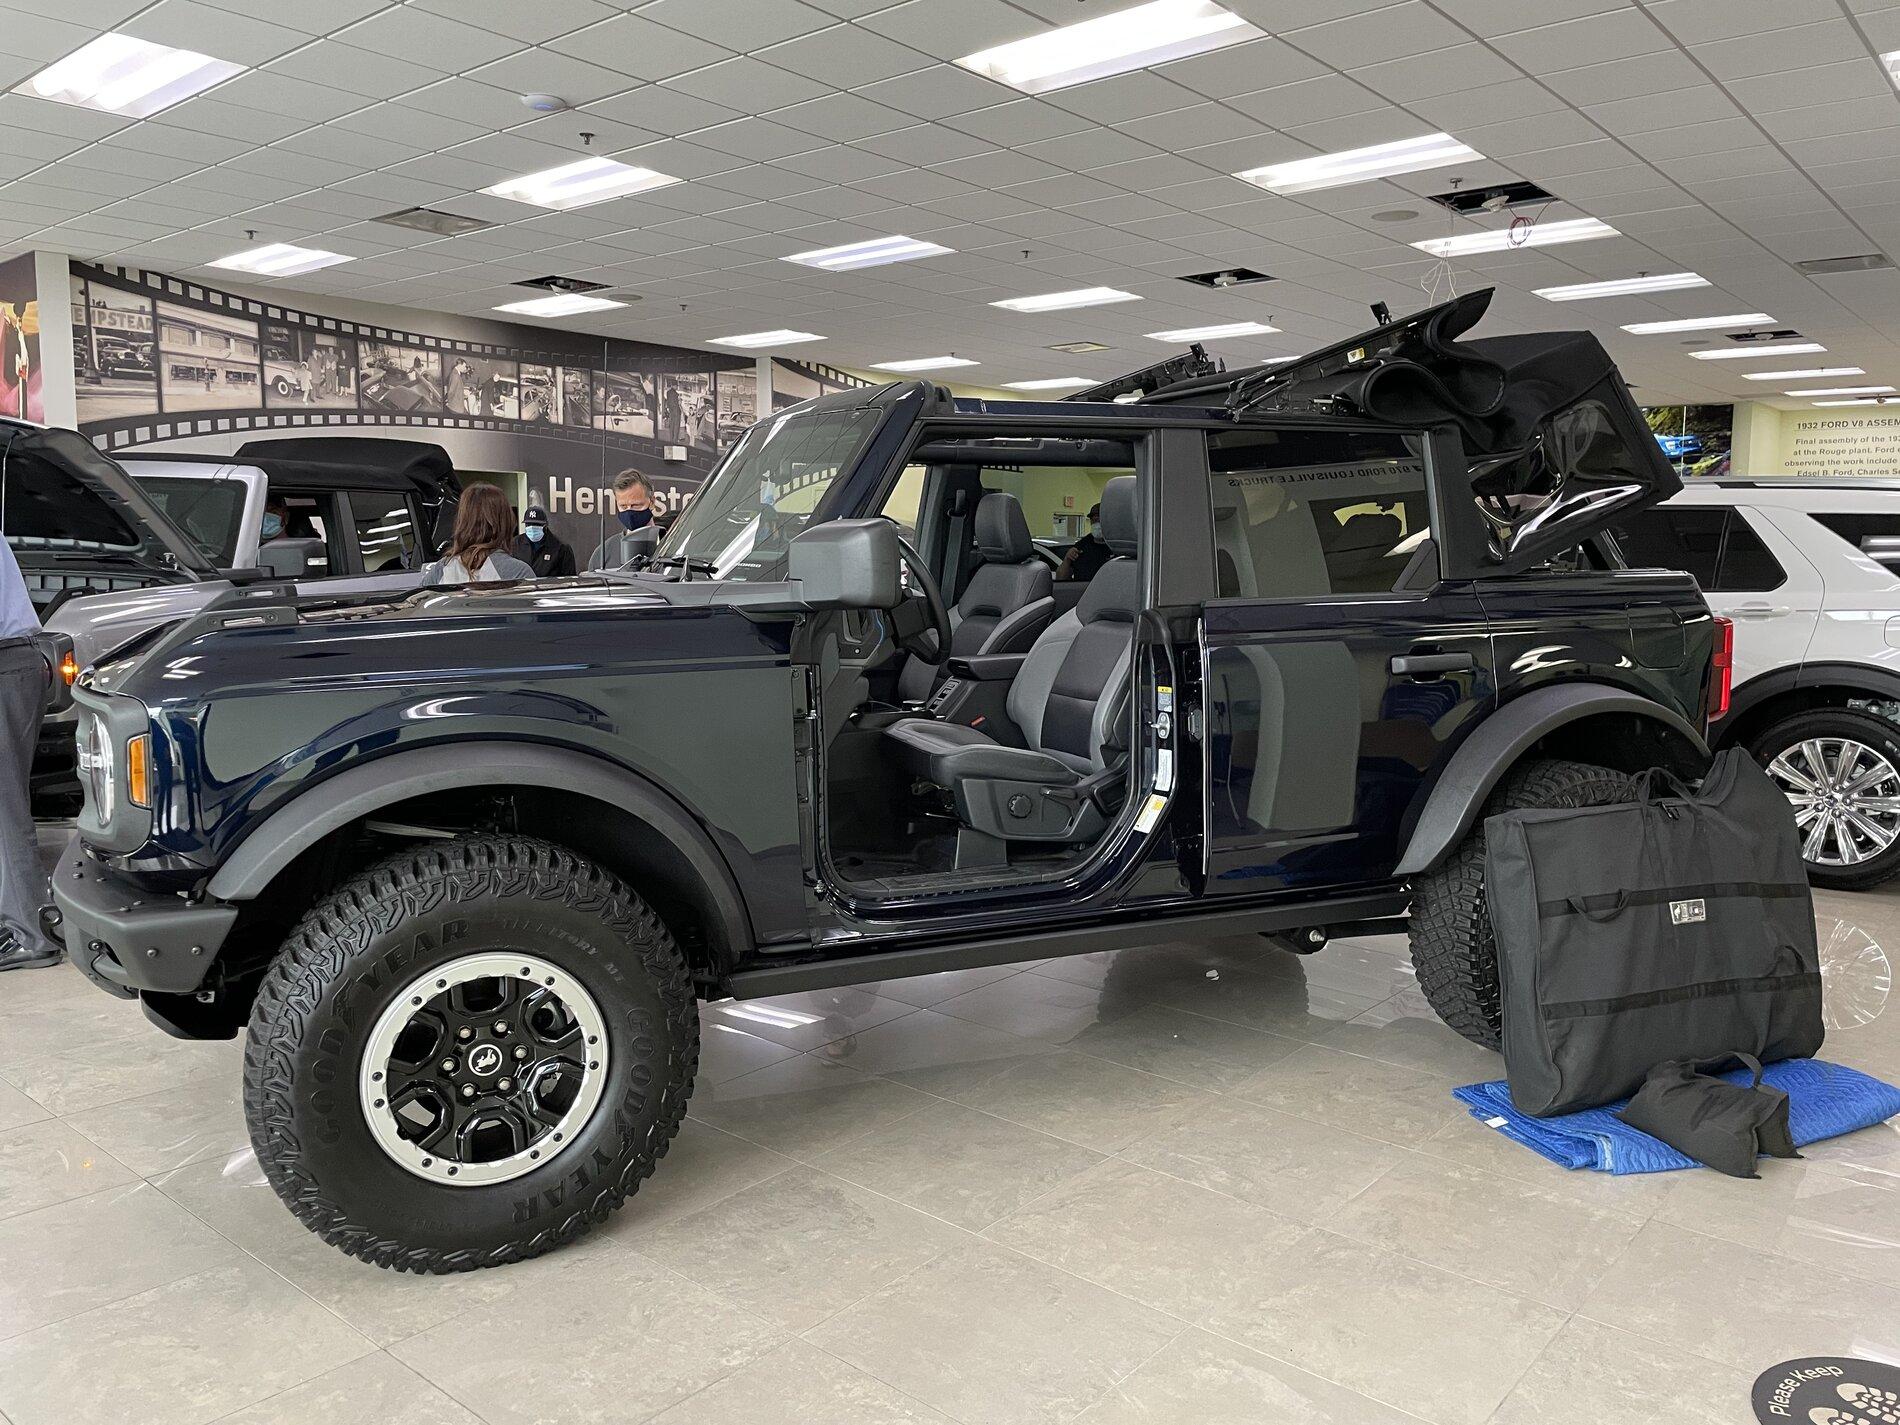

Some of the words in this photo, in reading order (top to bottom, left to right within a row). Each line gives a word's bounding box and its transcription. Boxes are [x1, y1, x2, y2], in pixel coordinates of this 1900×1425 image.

[1821, 420, 1849, 428] FORD
[1852, 419, 1864, 427] V8
[1818, 436, 1858, 444] assembly
[1767, 1378, 1801, 1417] Please
[1789, 1366, 1844, 1382] Keep
